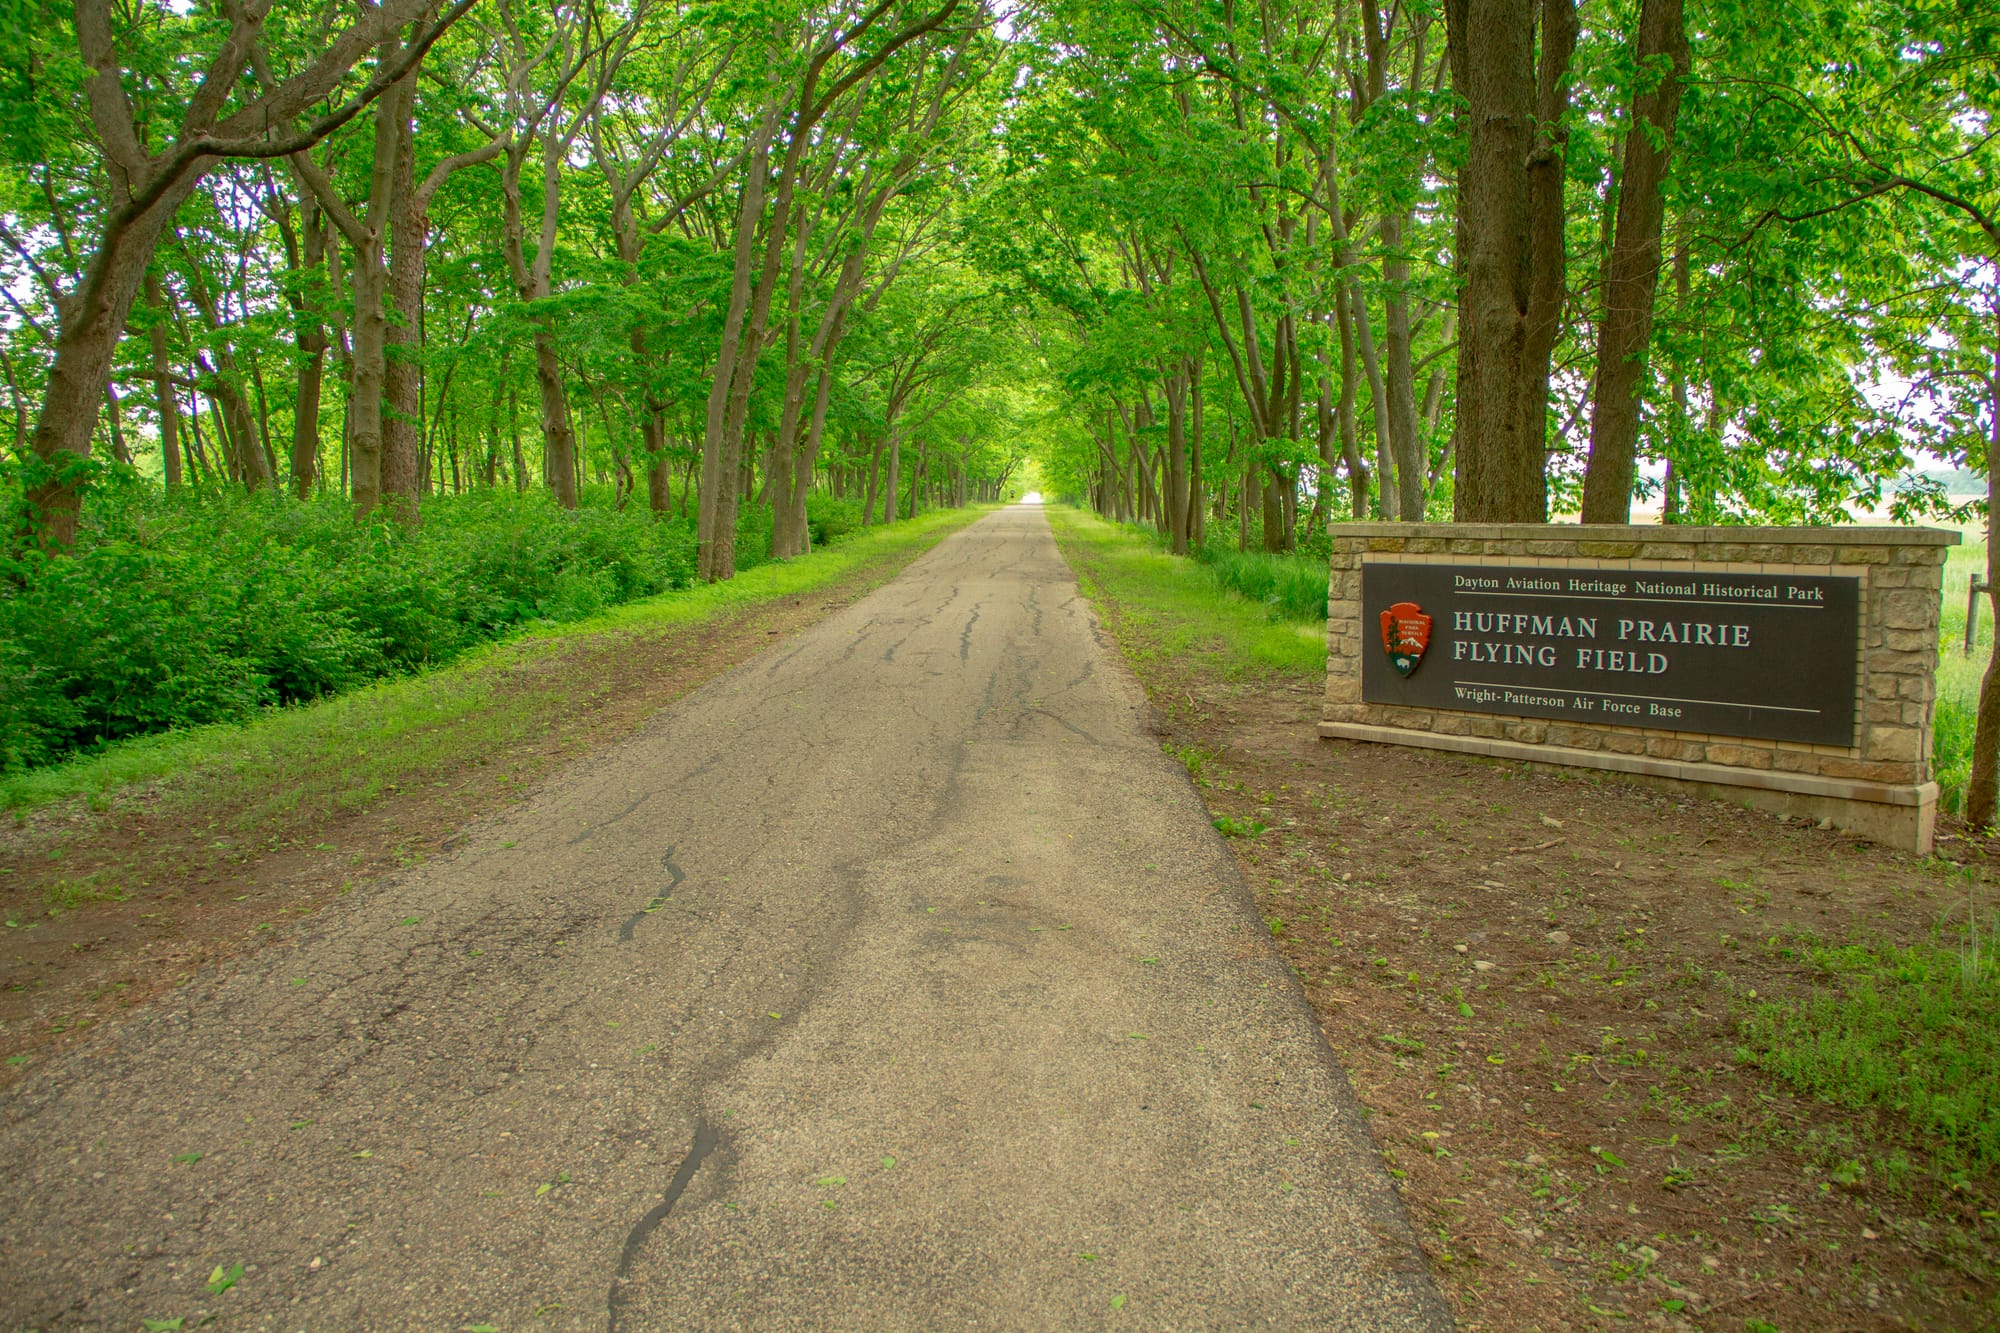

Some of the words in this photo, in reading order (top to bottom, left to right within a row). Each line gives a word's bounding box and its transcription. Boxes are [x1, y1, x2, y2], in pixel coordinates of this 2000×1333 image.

[1455, 576, 1498, 591] Dayton
[1507, 578, 1559, 590] Aviation
[1569, 579, 1626, 595] Heritage
[1636, 582, 1696, 595] National
[1703, 584, 1776, 598] Historical
[1788, 587, 1823, 599] Park
[1454, 612, 1597, 638] HUFFMAN
[1618, 620, 1749, 646] PRAIRIE
[1454, 641, 1556, 666] FLYING
[1577, 649, 1667, 673] FIELD
[1573, 697, 1594, 709] Air
[1603, 700, 1640, 713] Force
[1650, 704, 1681, 717] Base
